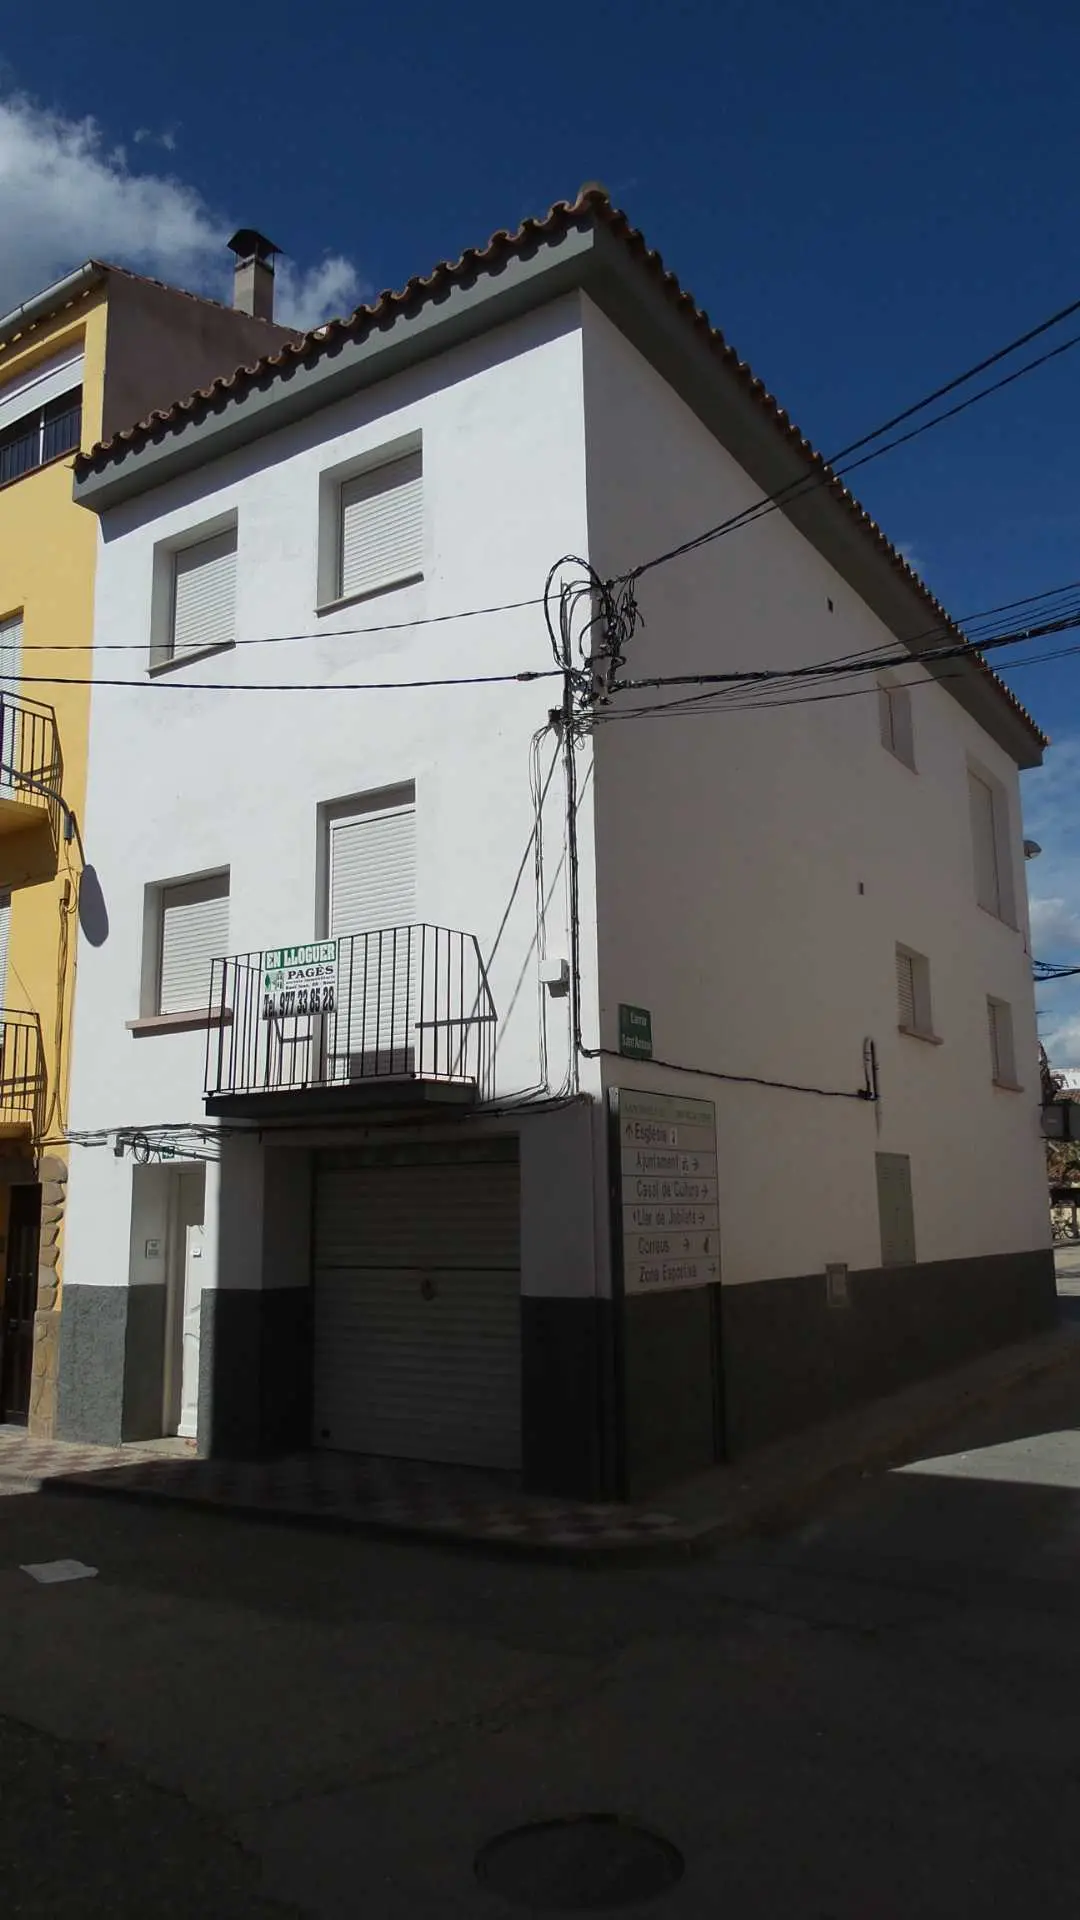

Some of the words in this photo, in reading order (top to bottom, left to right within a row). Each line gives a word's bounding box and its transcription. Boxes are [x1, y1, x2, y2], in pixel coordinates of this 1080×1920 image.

[266, 951, 281, 969] EN
[283, 943, 335, 967] LLOGUER
[288, 964, 334, 980] PAGÈS
[279, 991, 295, 1016] 977
[297, 988, 307, 1014] 33
[310, 987, 321, 1013] 85
[322, 986, 334, 1011] 28
